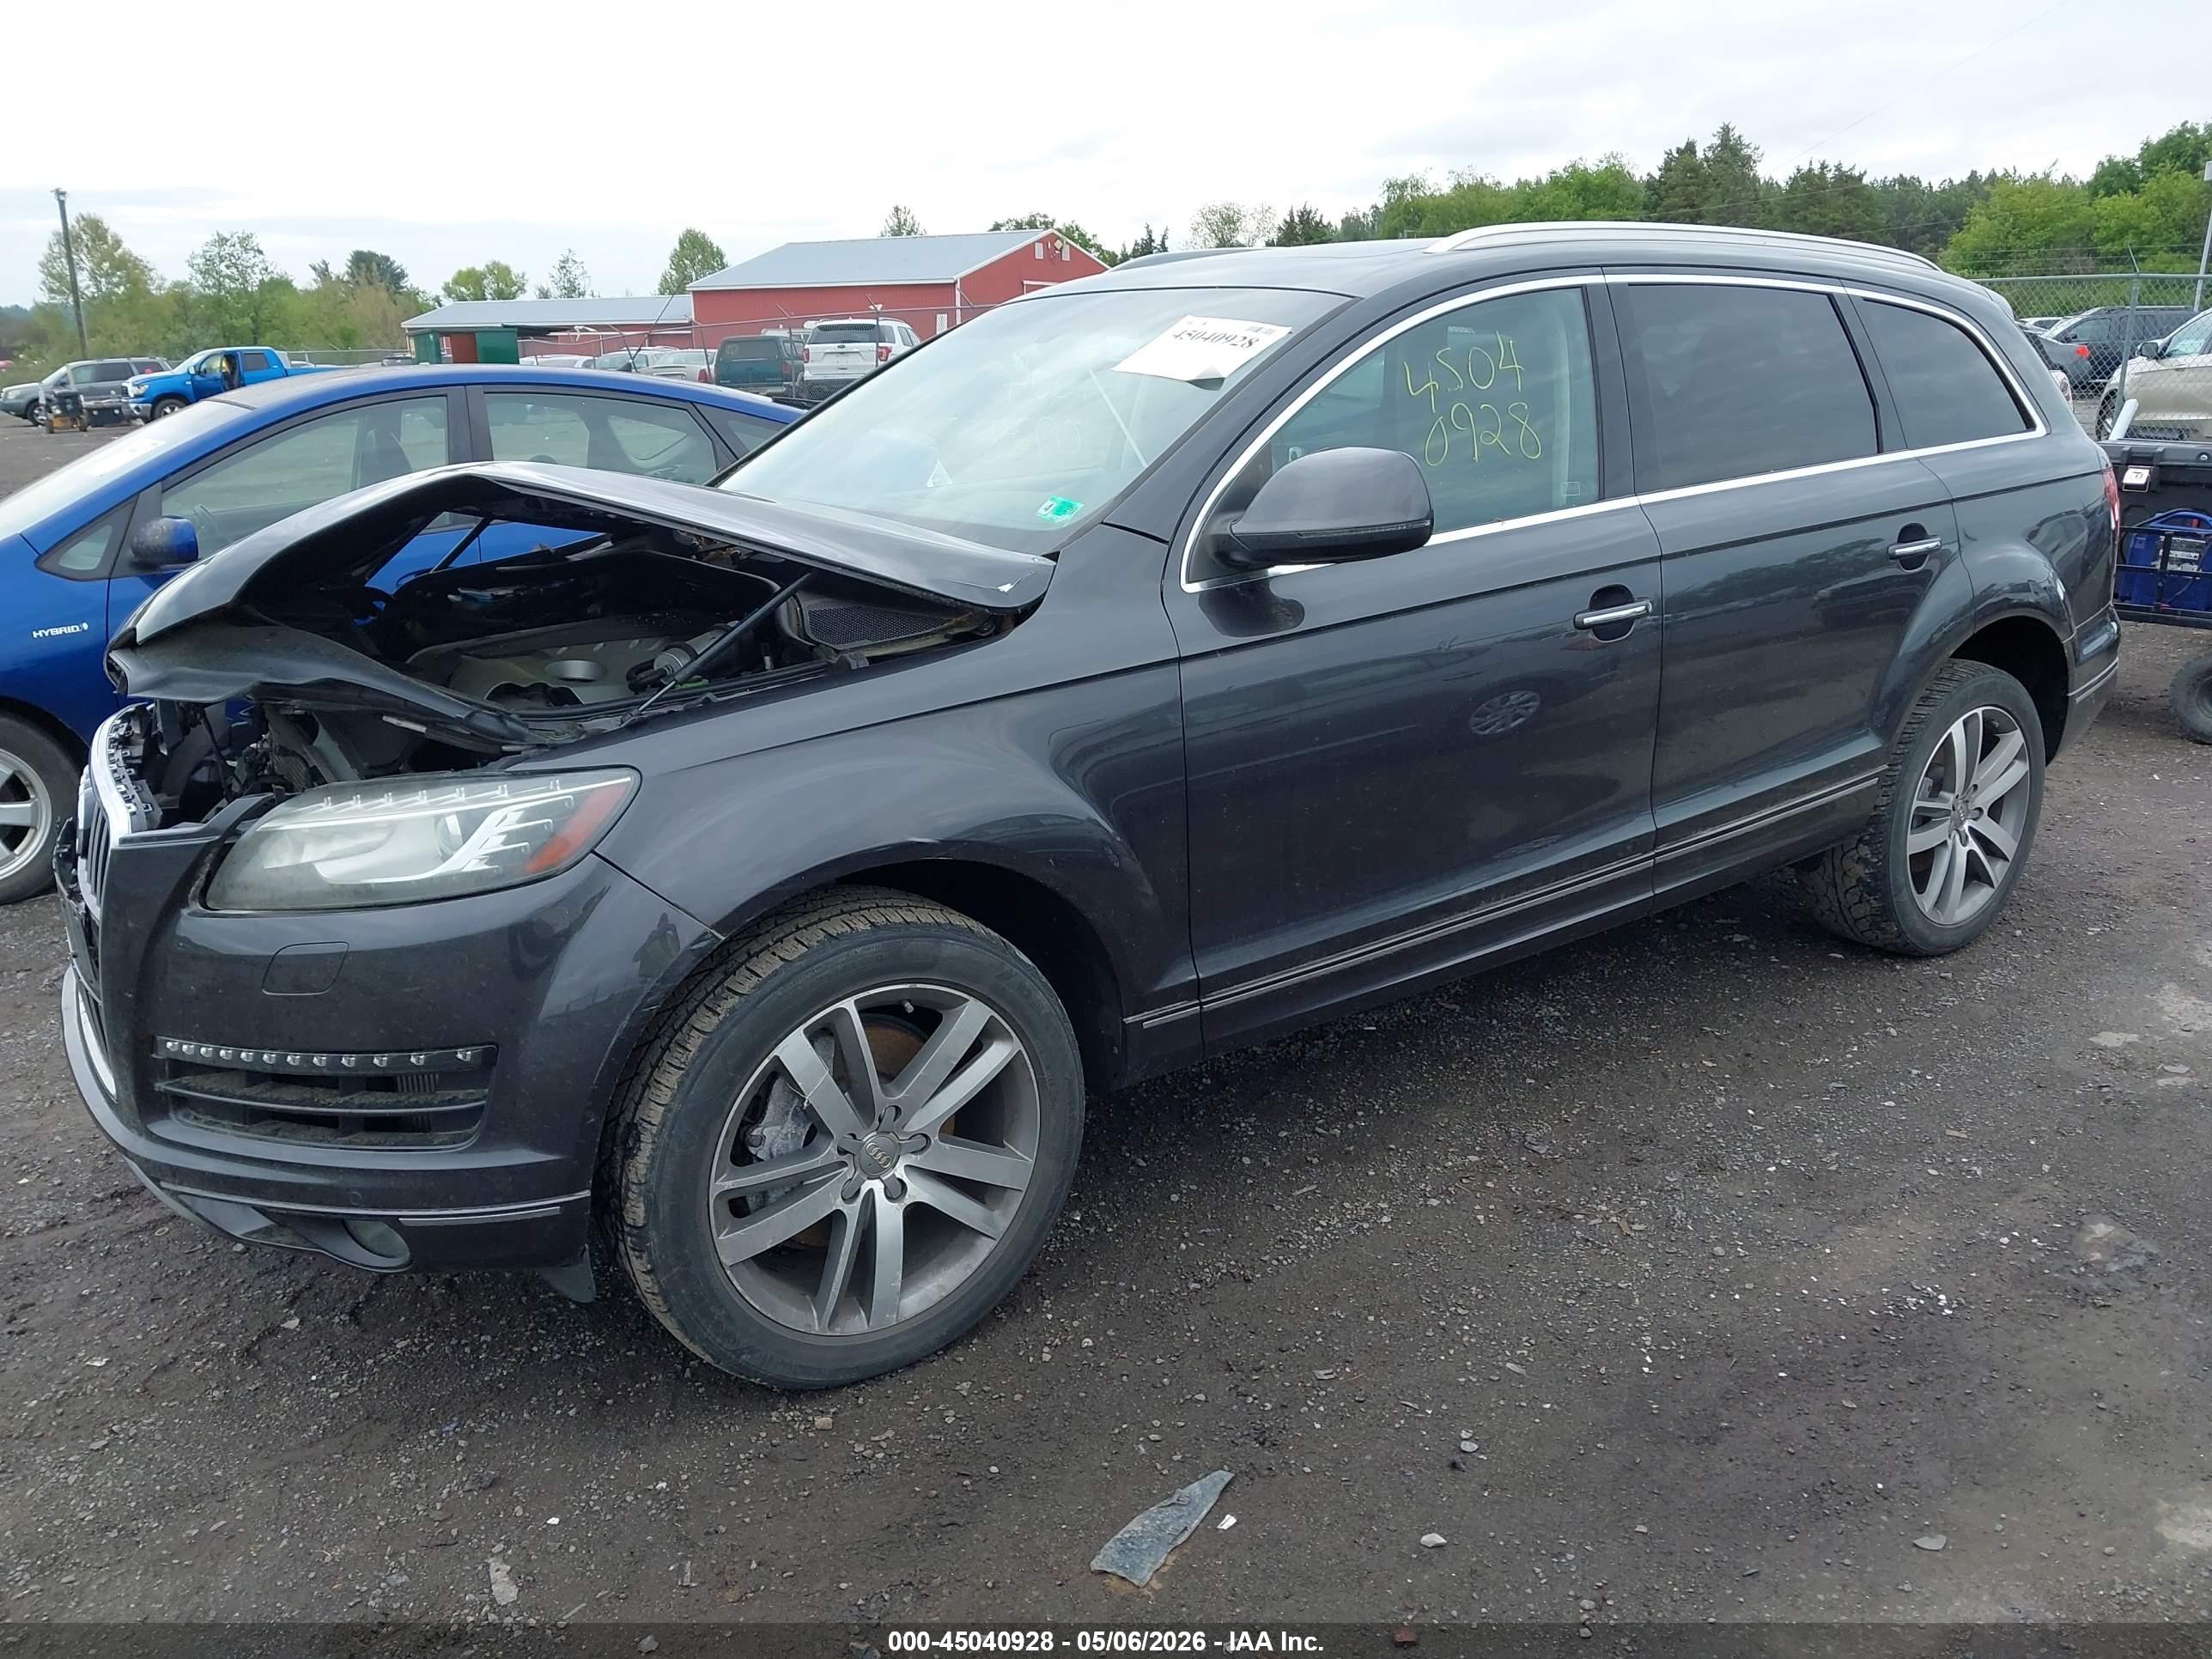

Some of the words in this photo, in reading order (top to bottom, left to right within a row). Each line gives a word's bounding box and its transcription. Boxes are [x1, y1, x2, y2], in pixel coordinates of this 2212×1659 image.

[1402, 330, 1526, 413] 4504
[1424, 402, 1542, 467] 0928
[32, 624, 80, 638] HYBRID
